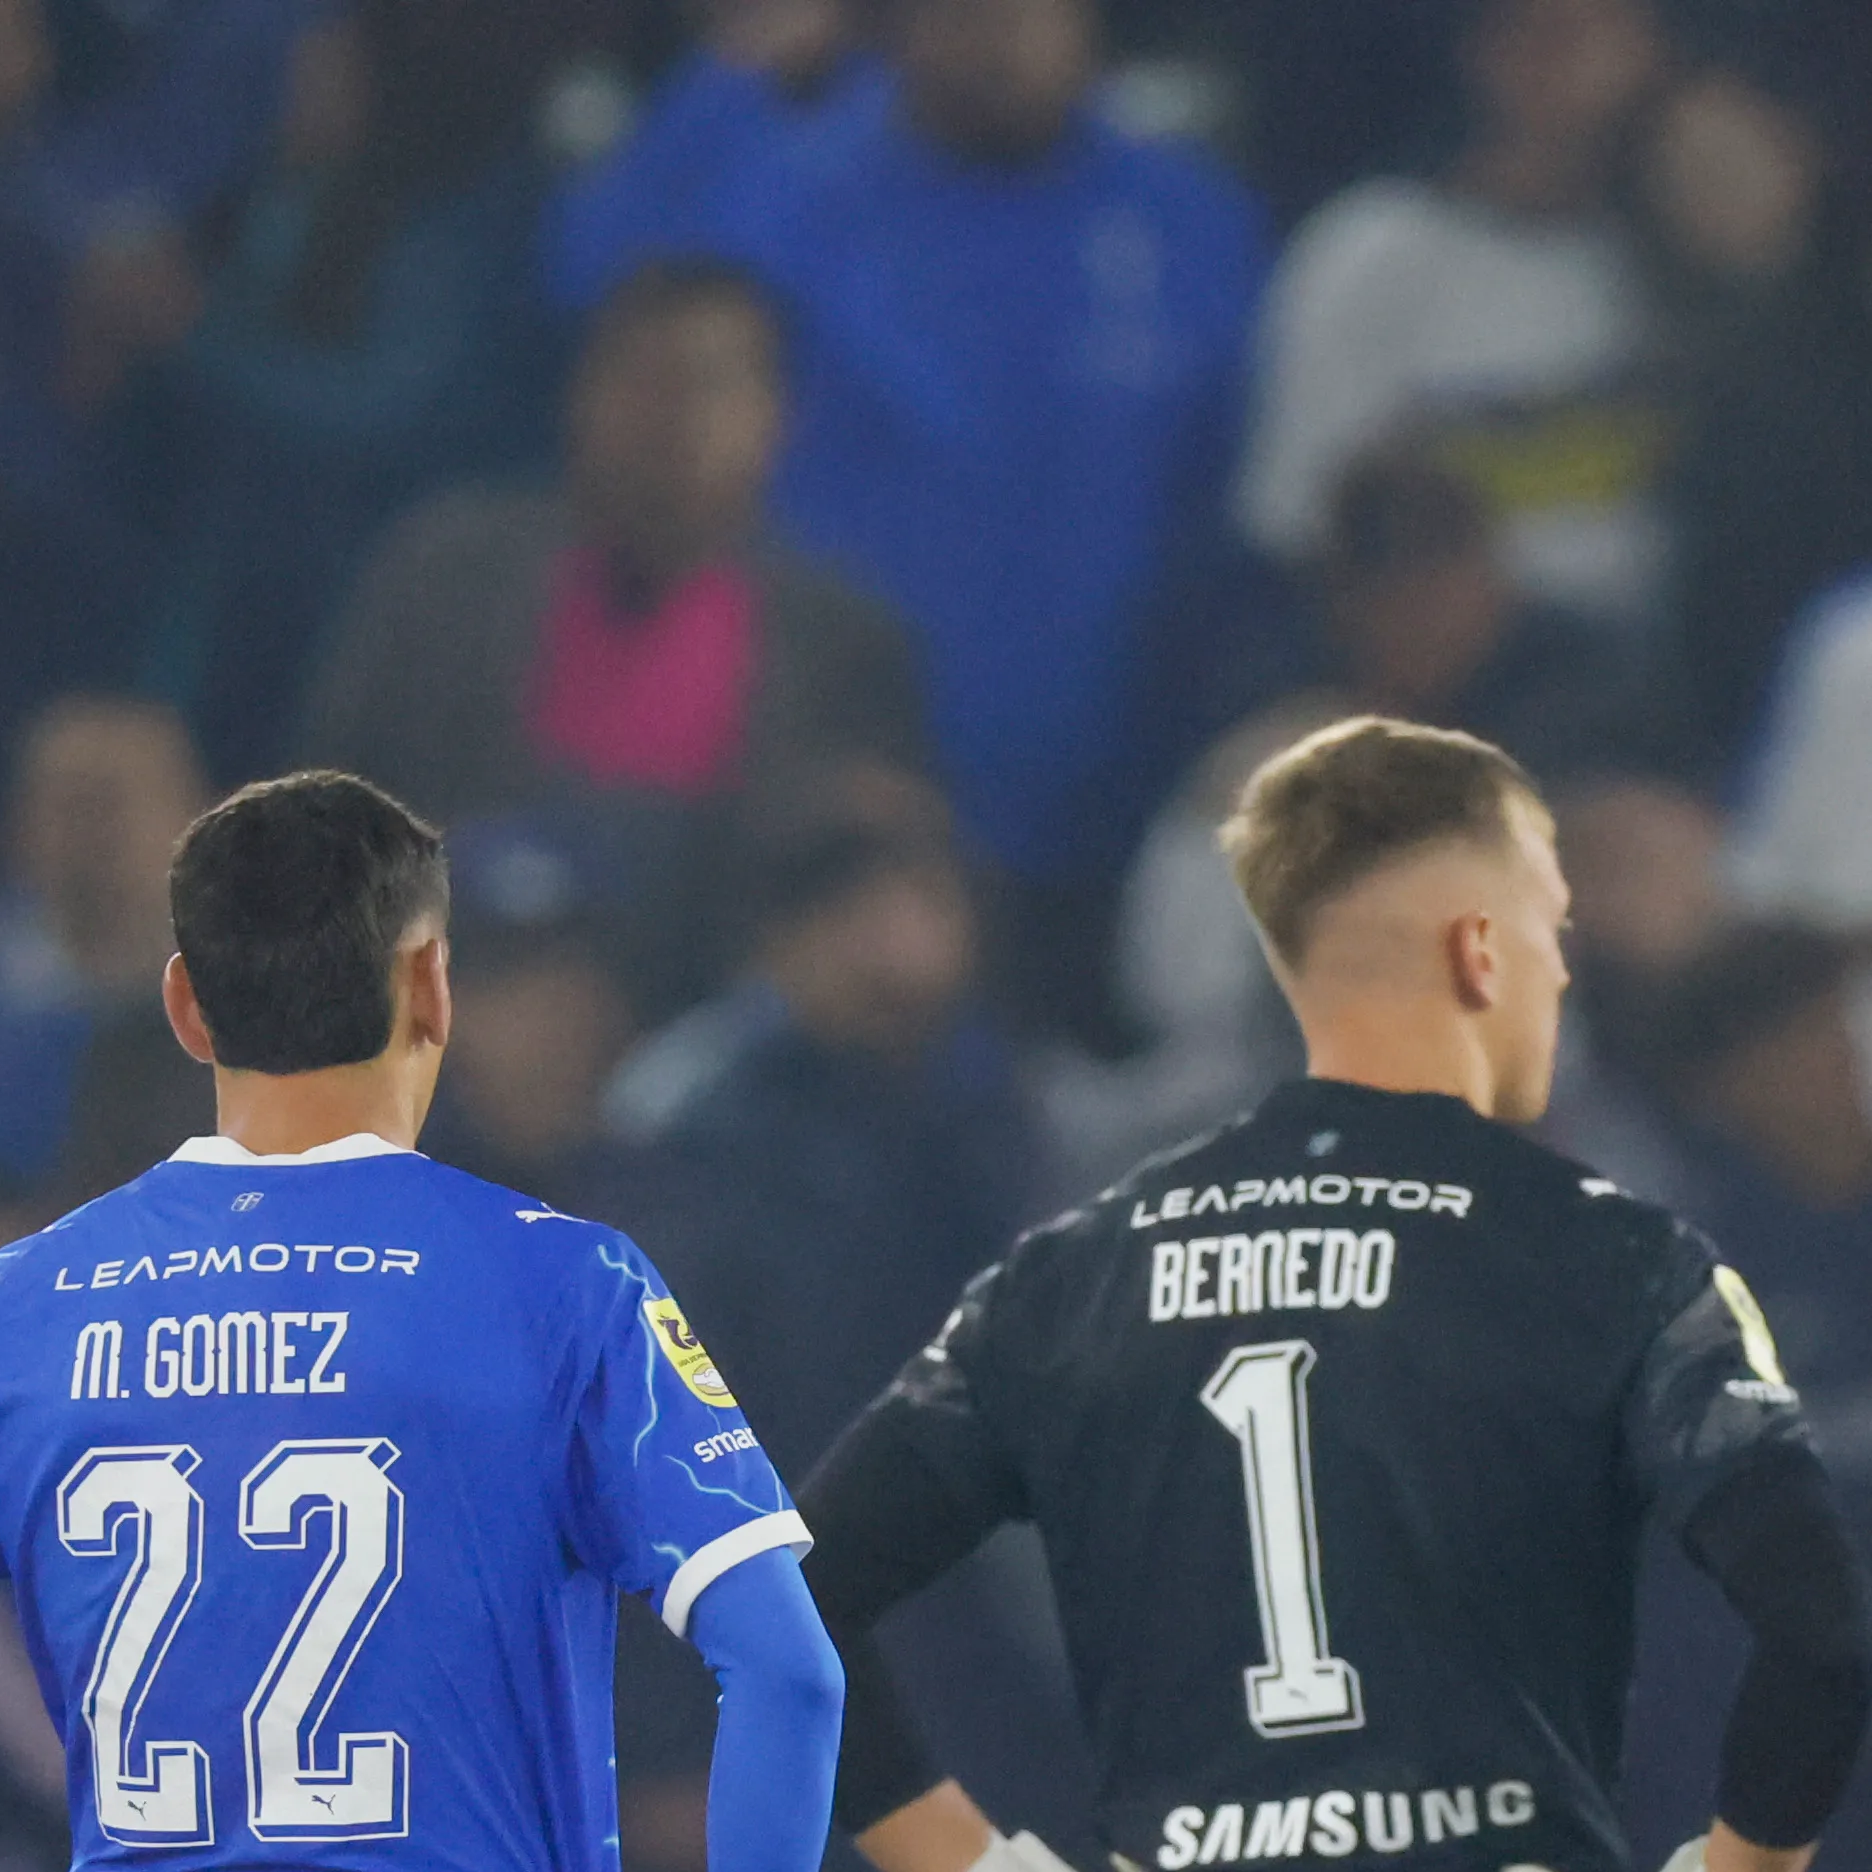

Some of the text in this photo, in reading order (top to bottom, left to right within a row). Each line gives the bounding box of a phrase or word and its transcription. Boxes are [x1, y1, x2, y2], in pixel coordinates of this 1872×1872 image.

[1131, 1174, 1473, 1230] LEAPMOTOR
[53, 1242, 421, 1291] LEAPMOTOR
[1148, 1228, 1396, 1322] BERNEDO
[70, 1310, 350, 1399] M. GOMEZ
[1199, 1338, 1365, 1739] 1
[58, 1436, 410, 1848] 22
[1156, 1778, 1536, 1871] SAMSUNG
